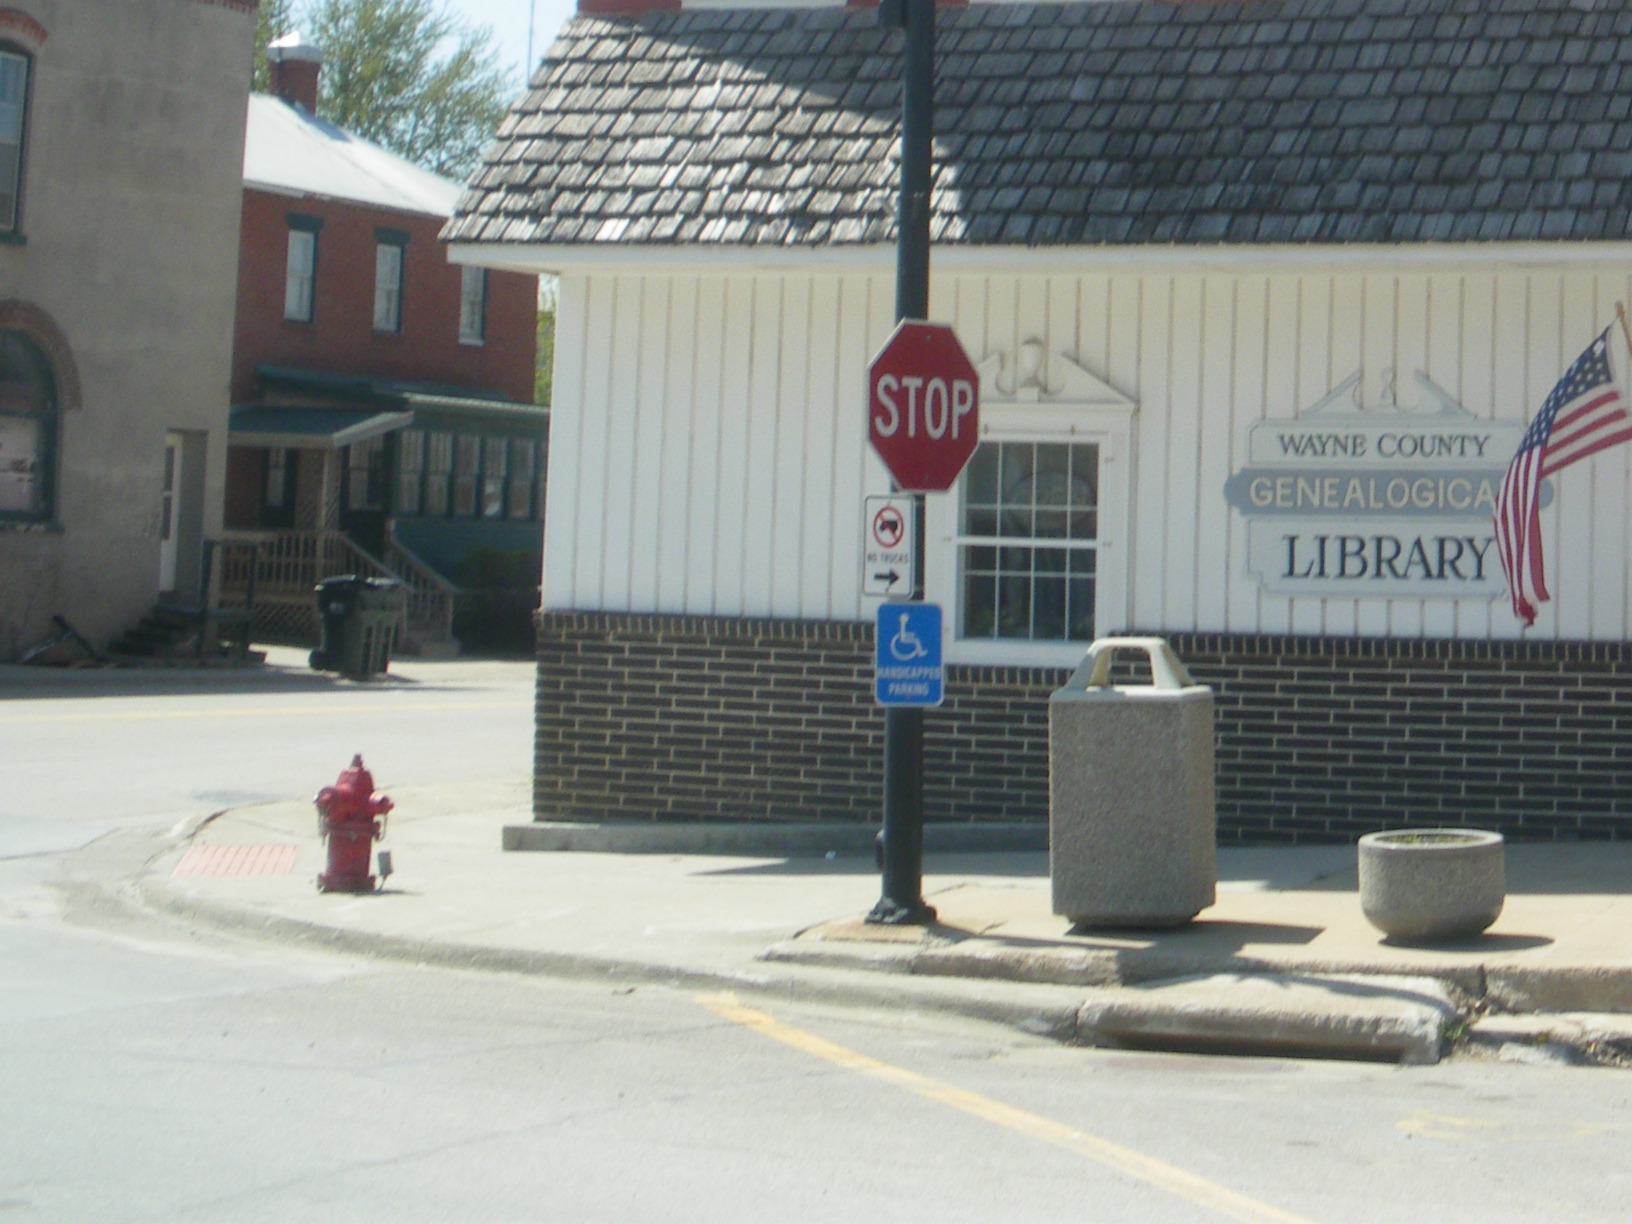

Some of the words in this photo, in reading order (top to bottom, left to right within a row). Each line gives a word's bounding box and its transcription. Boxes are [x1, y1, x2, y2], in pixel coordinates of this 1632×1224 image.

[875, 373, 974, 440] STOP
[1278, 433, 1367, 458] WAYNE
[1377, 432, 1491, 458] COUNTY
[1250, 477, 1497, 510] GENEALOGICA
[1282, 533, 1496, 581] LIBRARY
[877, 666, 942, 680] HANDICAPPED
[888, 683, 930, 696] PARKING
